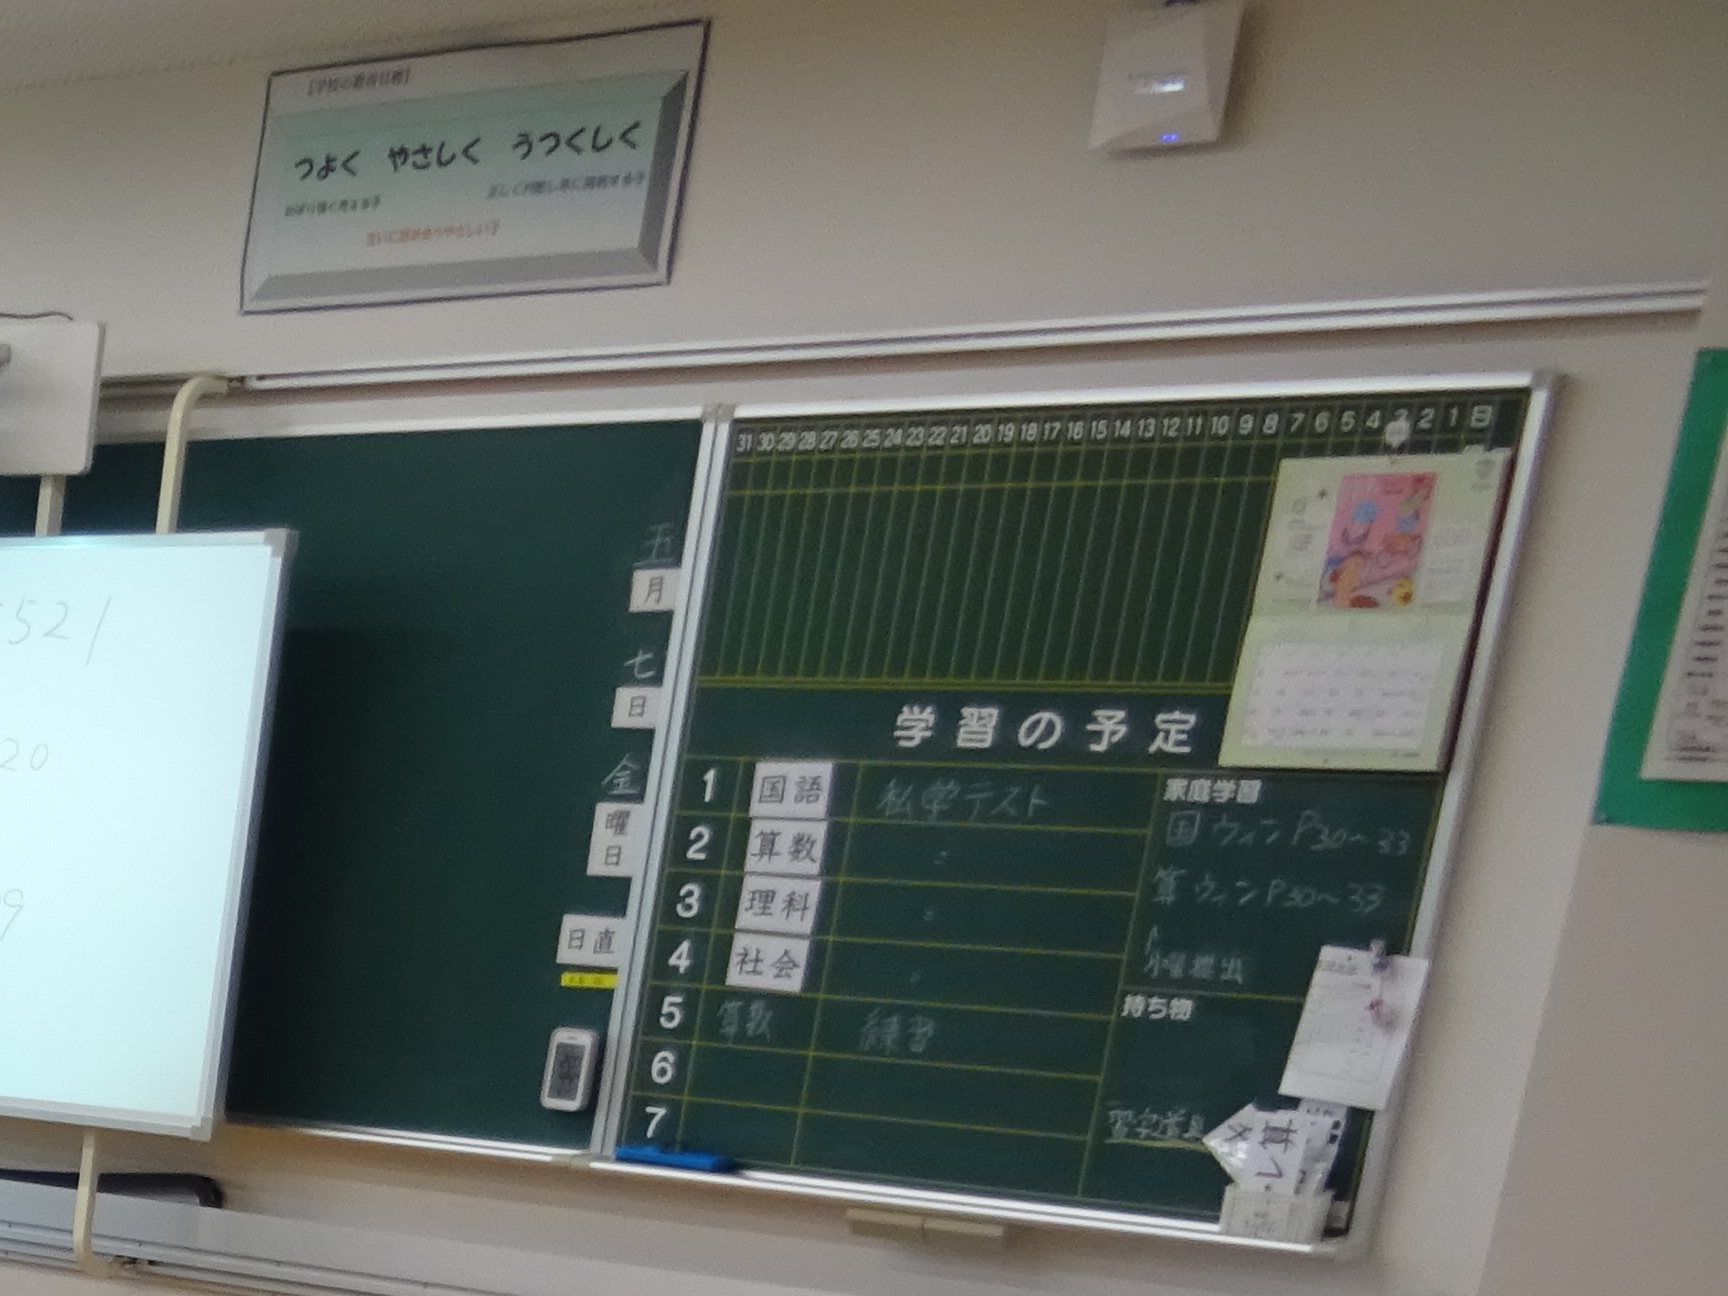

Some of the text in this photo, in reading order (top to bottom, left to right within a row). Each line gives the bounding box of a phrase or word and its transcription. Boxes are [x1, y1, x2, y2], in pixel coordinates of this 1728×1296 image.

[294, 120, 642, 181] つよく やさしく うつくしく
[737, 434, 752, 452] 31
[757, 433, 774, 451] 30
[778, 433, 795, 451] 29
[799, 432, 815, 450] 28
[820, 430, 837, 449] 27
[841, 429, 858, 448] 26
[862, 429, 880, 447] 25
[885, 428, 902, 446] 24
[906, 427, 924, 446] 23
[928, 426, 946, 444] 22
[950, 425, 967, 444] 21
[973, 424, 991, 444] 20
[997, 423, 1014, 442] 19
[1020, 422, 1036, 442] 18
[1044, 421, 1060, 441] 17
[1068, 420, 1083, 439] 16
[1090, 420, 1107, 439] 15
[1114, 419, 1131, 438] 14
[1138, 417, 1156, 438] 13
[1162, 415, 1180, 437] 12
[1187, 414, 1201, 435] 11
[1212, 414, 1229, 436] 10
[1240, 413, 1254, 435] 9
[1263, 412, 1279, 434] 8
[1291, 412, 1305, 432] 7
[1316, 411, 1330, 433] 6
[1341, 410, 1355, 432] 5
[1366, 408, 1380, 429] 4
[1419, 407, 1434, 428] 2
[1449, 406, 1457, 427] 1
[1471, 405, 1492, 428] 日
[644, 576, 665, 604] 月
[624, 649, 655, 679] 七
[628, 695, 647, 719] 日
[893, 702, 1198, 755] 学習の予定
[601, 752, 641, 795] 金
[702, 767, 718, 804] 1
[757, 774, 824, 804] 国語
[1162, 778, 1263, 805] 家庭学習
[603, 809, 631, 867] 曜日
[685, 825, 712, 862] 2
[750, 830, 820, 865] 算数
[675, 882, 703, 920] 3
[744, 889, 812, 924] 理科
[568, 928, 616, 955] 日直
[667, 938, 693, 975] 4
[735, 946, 800, 981] 社会
[658, 994, 685, 1030] 5
[1120, 993, 1194, 1021] 持ち物
[650, 1049, 676, 1085] 6
[644, 1106, 668, 1139] 7
